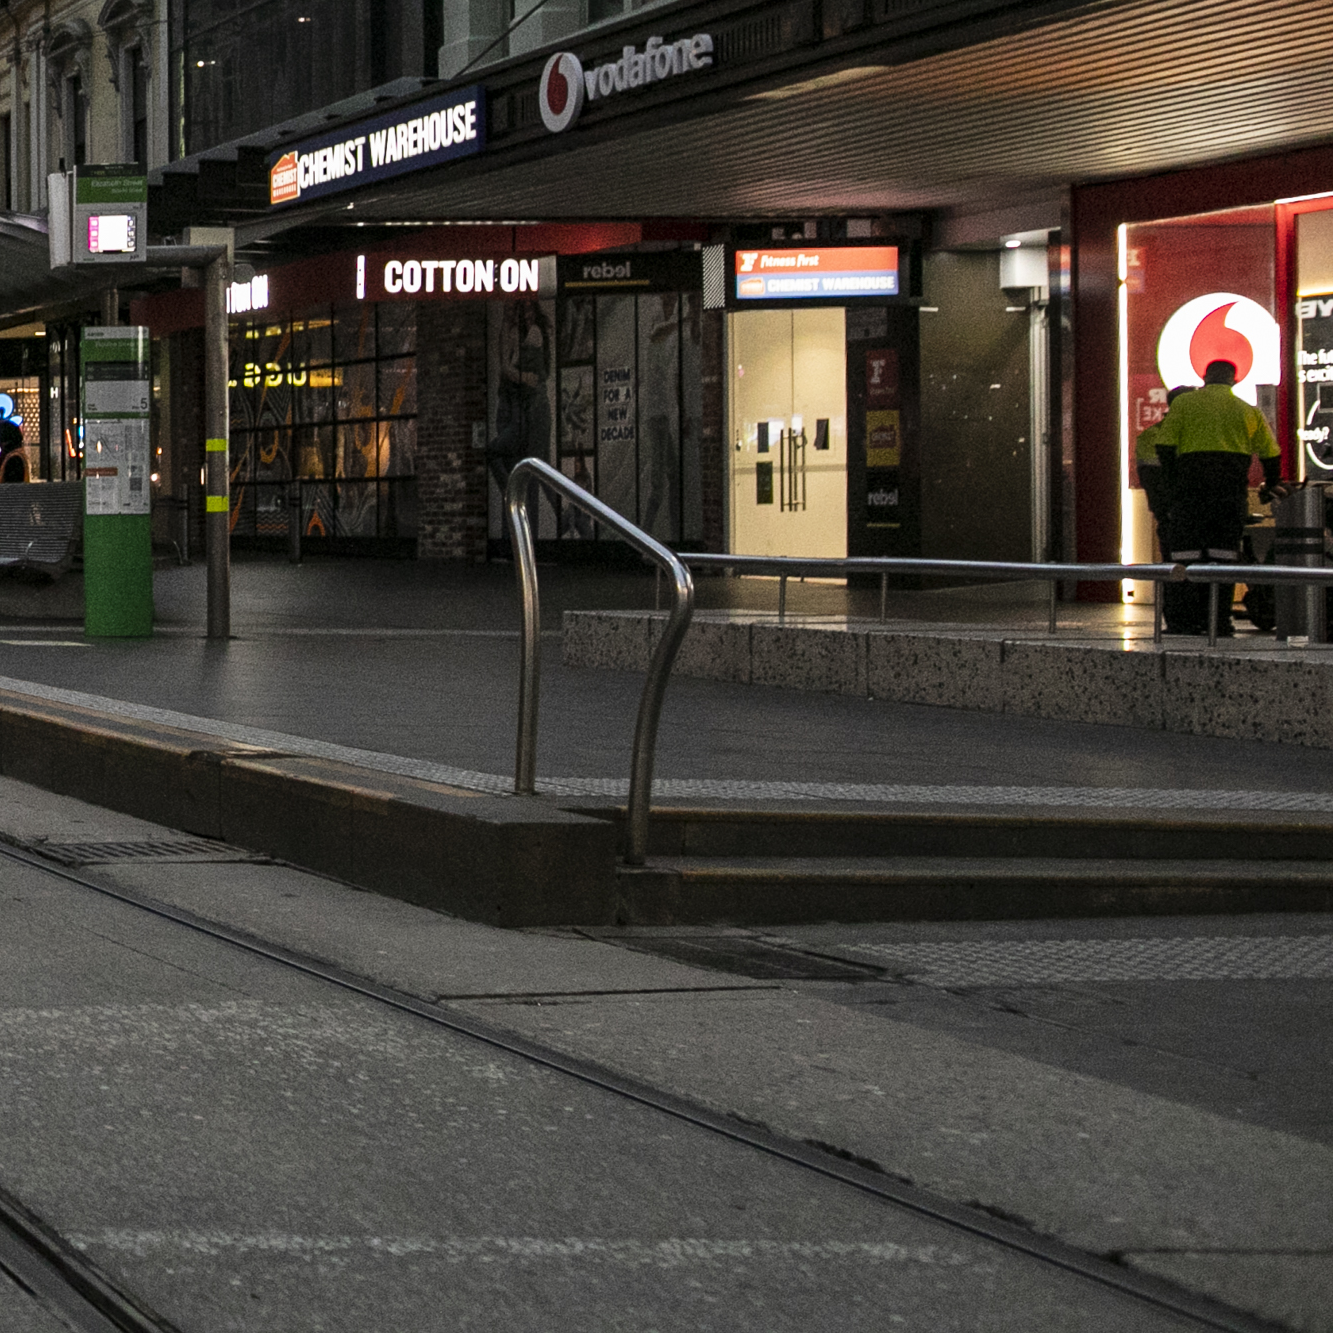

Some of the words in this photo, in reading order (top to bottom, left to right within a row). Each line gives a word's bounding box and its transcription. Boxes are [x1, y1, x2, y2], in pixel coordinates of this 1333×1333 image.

[584, 33, 714, 101] vodafone
[299, 136, 366, 189] CHEMIST
[369, 100, 477, 167] WAREHOUSE
[384, 261, 495, 294] COTTON
[499, 260, 540, 294] ON
[583, 262, 631, 278] rebel
[767, 277, 820, 293] CHEMIST
[821, 276, 895, 291] WAREHOUSE
[604, 369, 631, 384] DENIM
[608, 407, 628, 421] NEW
[867, 490, 899, 507] rebel
